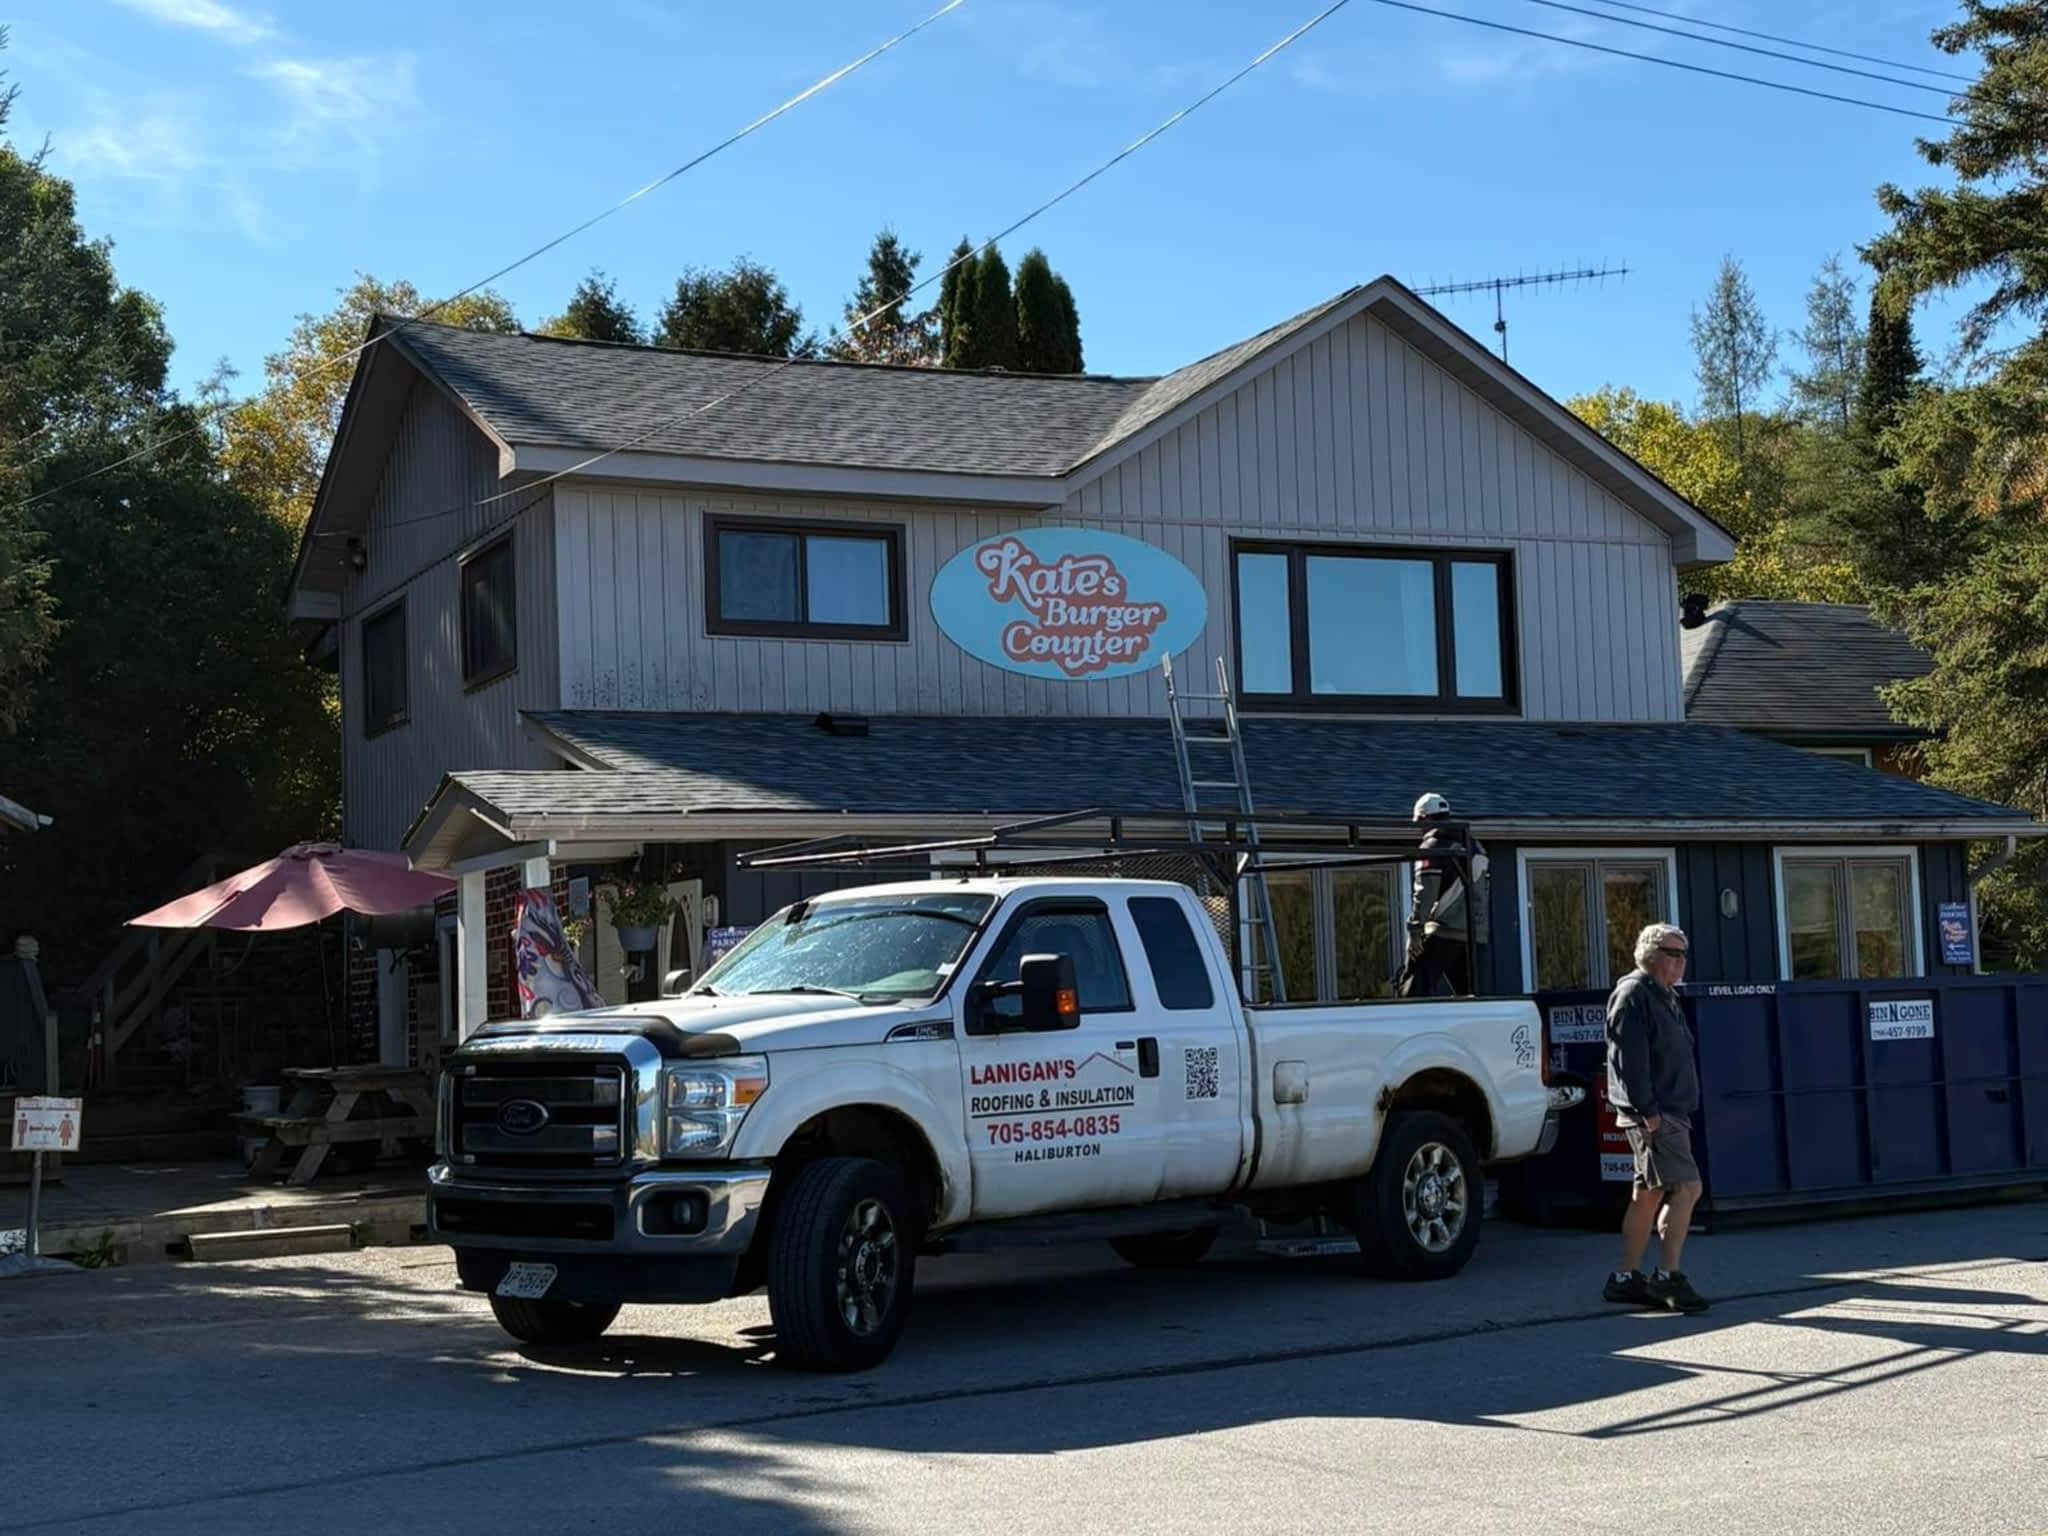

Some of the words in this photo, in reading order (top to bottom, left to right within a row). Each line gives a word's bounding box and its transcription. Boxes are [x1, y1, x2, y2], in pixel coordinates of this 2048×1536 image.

[980, 541, 1120, 607] Kate's
[1043, 598, 1159, 632] Burger
[1007, 625, 1142, 668] Counter
[1708, 985, 1732, 996] LEVEL
[1733, 985, 1755, 995] LOAD
[1756, 984, 1776, 994] ONLY
[1553, 1010, 1573, 1024] BIN
[1575, 1007, 1584, 1025] N
[1870, 1007, 1888, 1019] BIN
[1889, 1003, 1898, 1022] N
[1900, 1005, 1930, 1019] GONE
[970, 1060, 1076, 1085] LANIGAN'S
[971, 1093, 1034, 1112] ROOFING
[1040, 1089, 1051, 1105] &
[1056, 1086, 1135, 1104] INSULATION
[987, 1114, 1120, 1144] 705-854-0835
[1015, 1144, 1100, 1163] HALIBURTON
